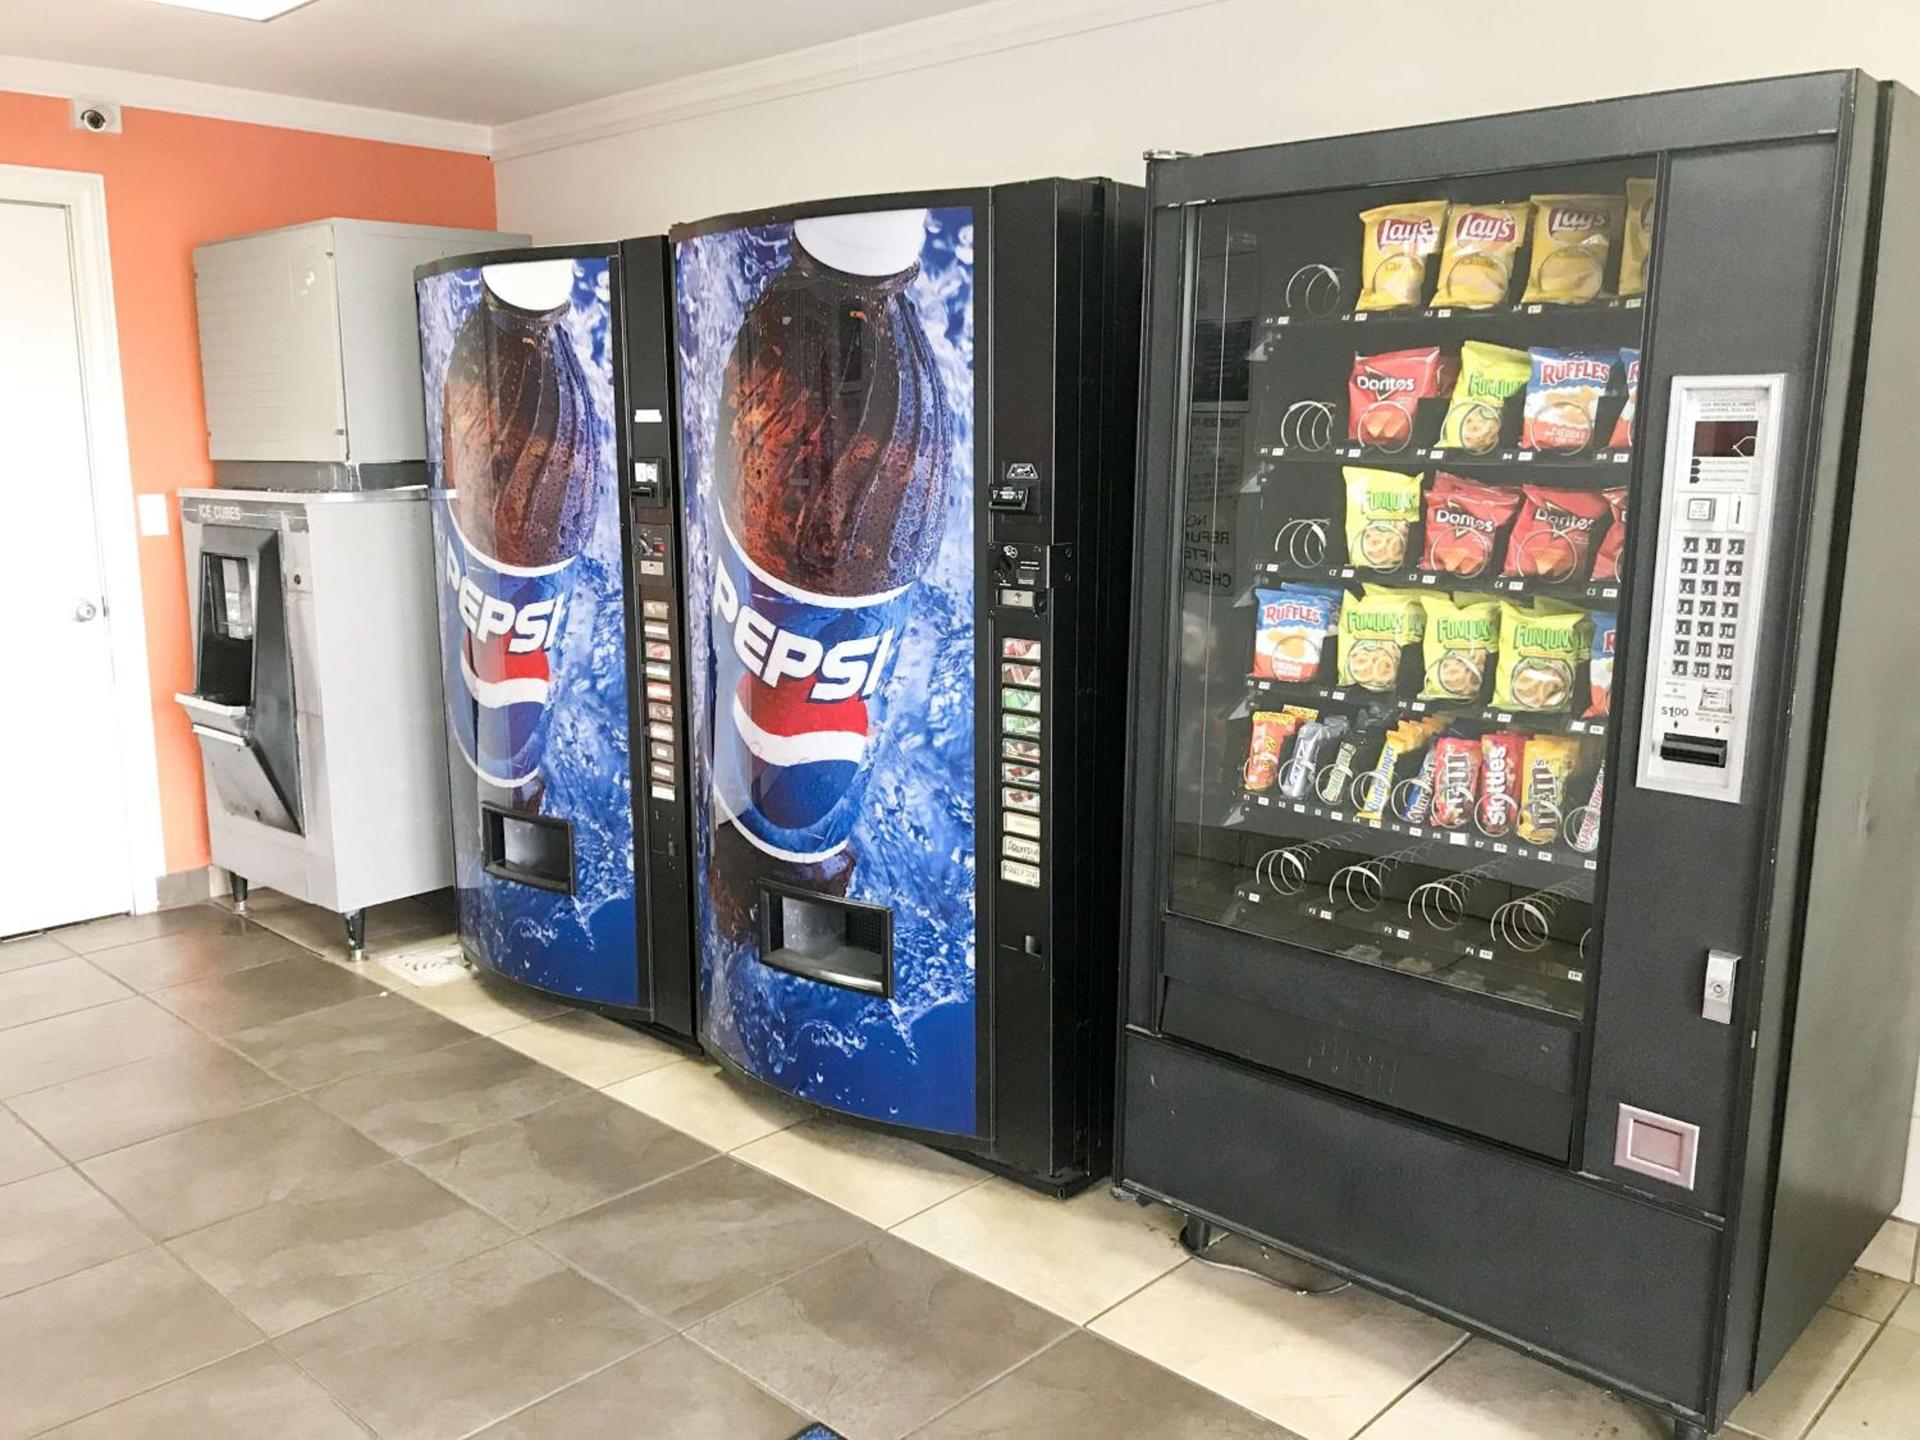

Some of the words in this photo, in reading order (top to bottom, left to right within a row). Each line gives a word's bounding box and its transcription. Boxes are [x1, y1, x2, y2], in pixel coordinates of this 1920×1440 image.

[1460, 213, 1512, 242] Lay's
[1356, 376, 1415, 392] Doritos
[1541, 360, 1610, 386] RUFFLES
[1436, 509, 1495, 533] Doritos
[446, 537, 565, 655] PEPSI
[1263, 603, 1322, 625] RUFFLES
[713, 558, 893, 701] PEPSI
[1513, 623, 1576, 650] FUNYUNS
